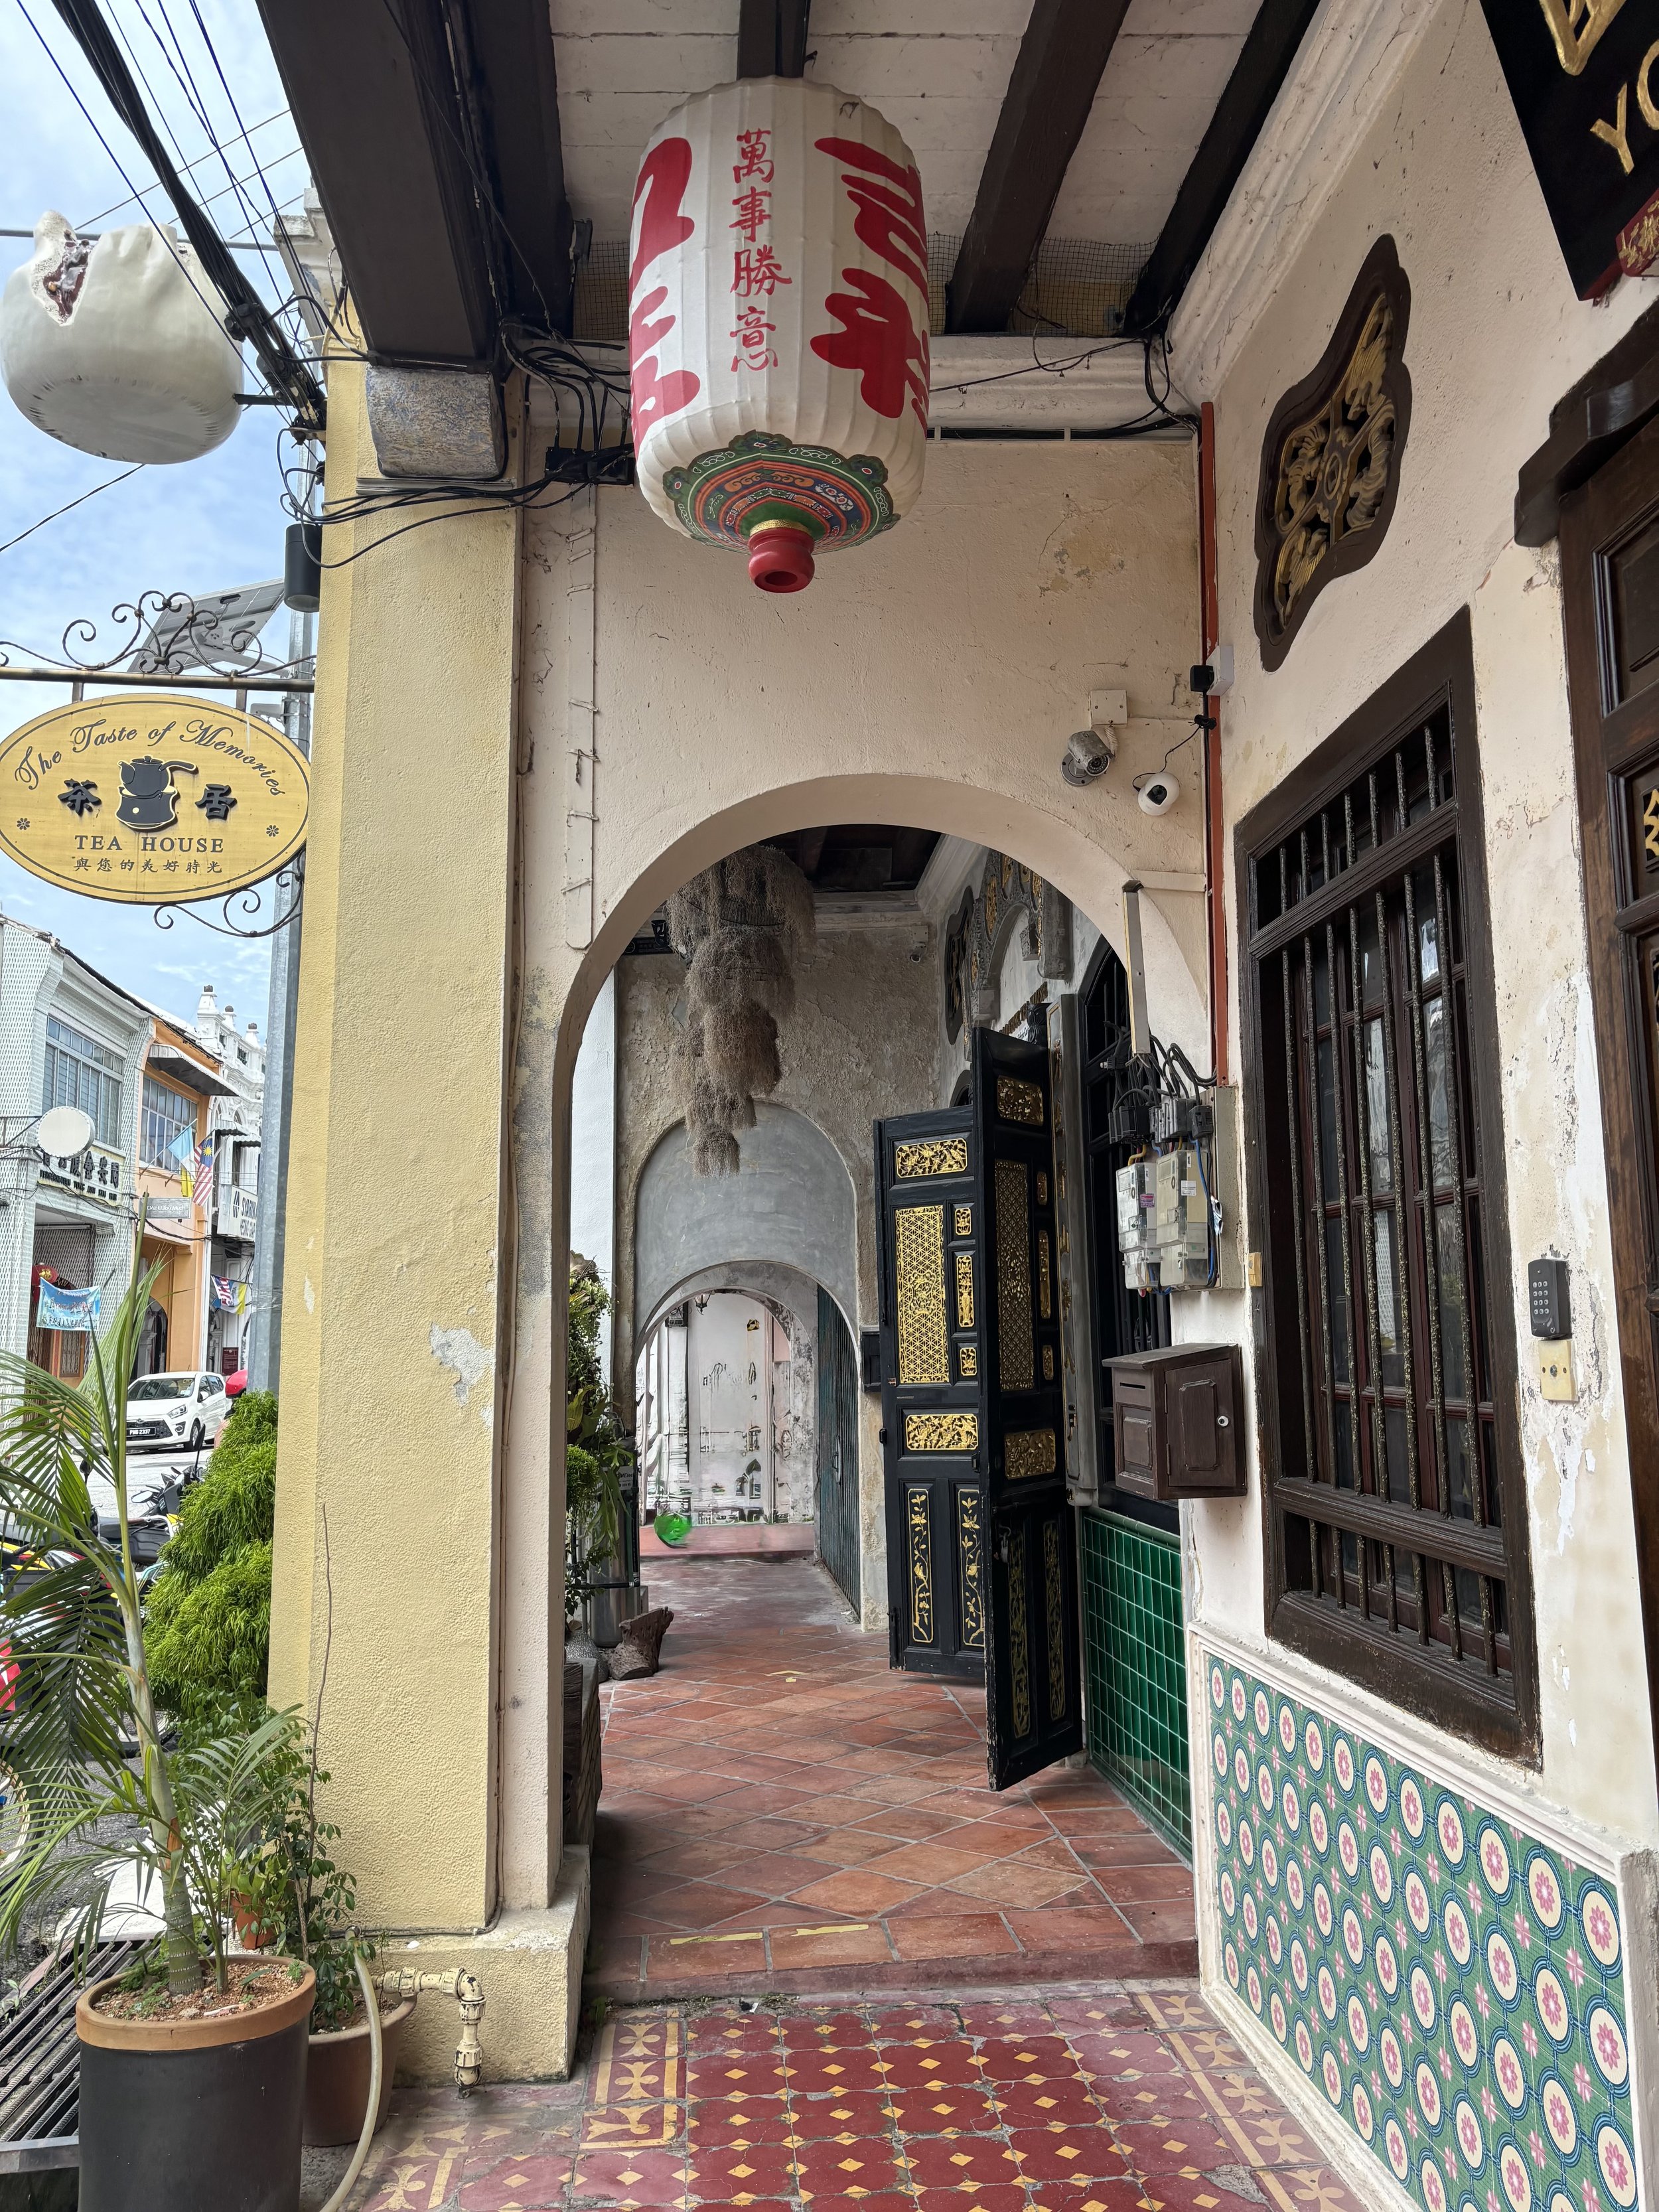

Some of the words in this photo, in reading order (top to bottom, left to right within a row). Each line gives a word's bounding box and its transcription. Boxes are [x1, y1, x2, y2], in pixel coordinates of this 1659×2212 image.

[730, 129, 792, 372] 萬事勝意
[15, 746, 62, 790] The
[70, 719, 137, 753] Taste
[147, 721, 177, 747] of
[179, 719, 286, 796] Memories
[58, 778, 102, 817] 茶
[195, 784, 238, 820] 居
[75, 835, 122, 851] TEA
[141, 836, 224, 853] HOUSE
